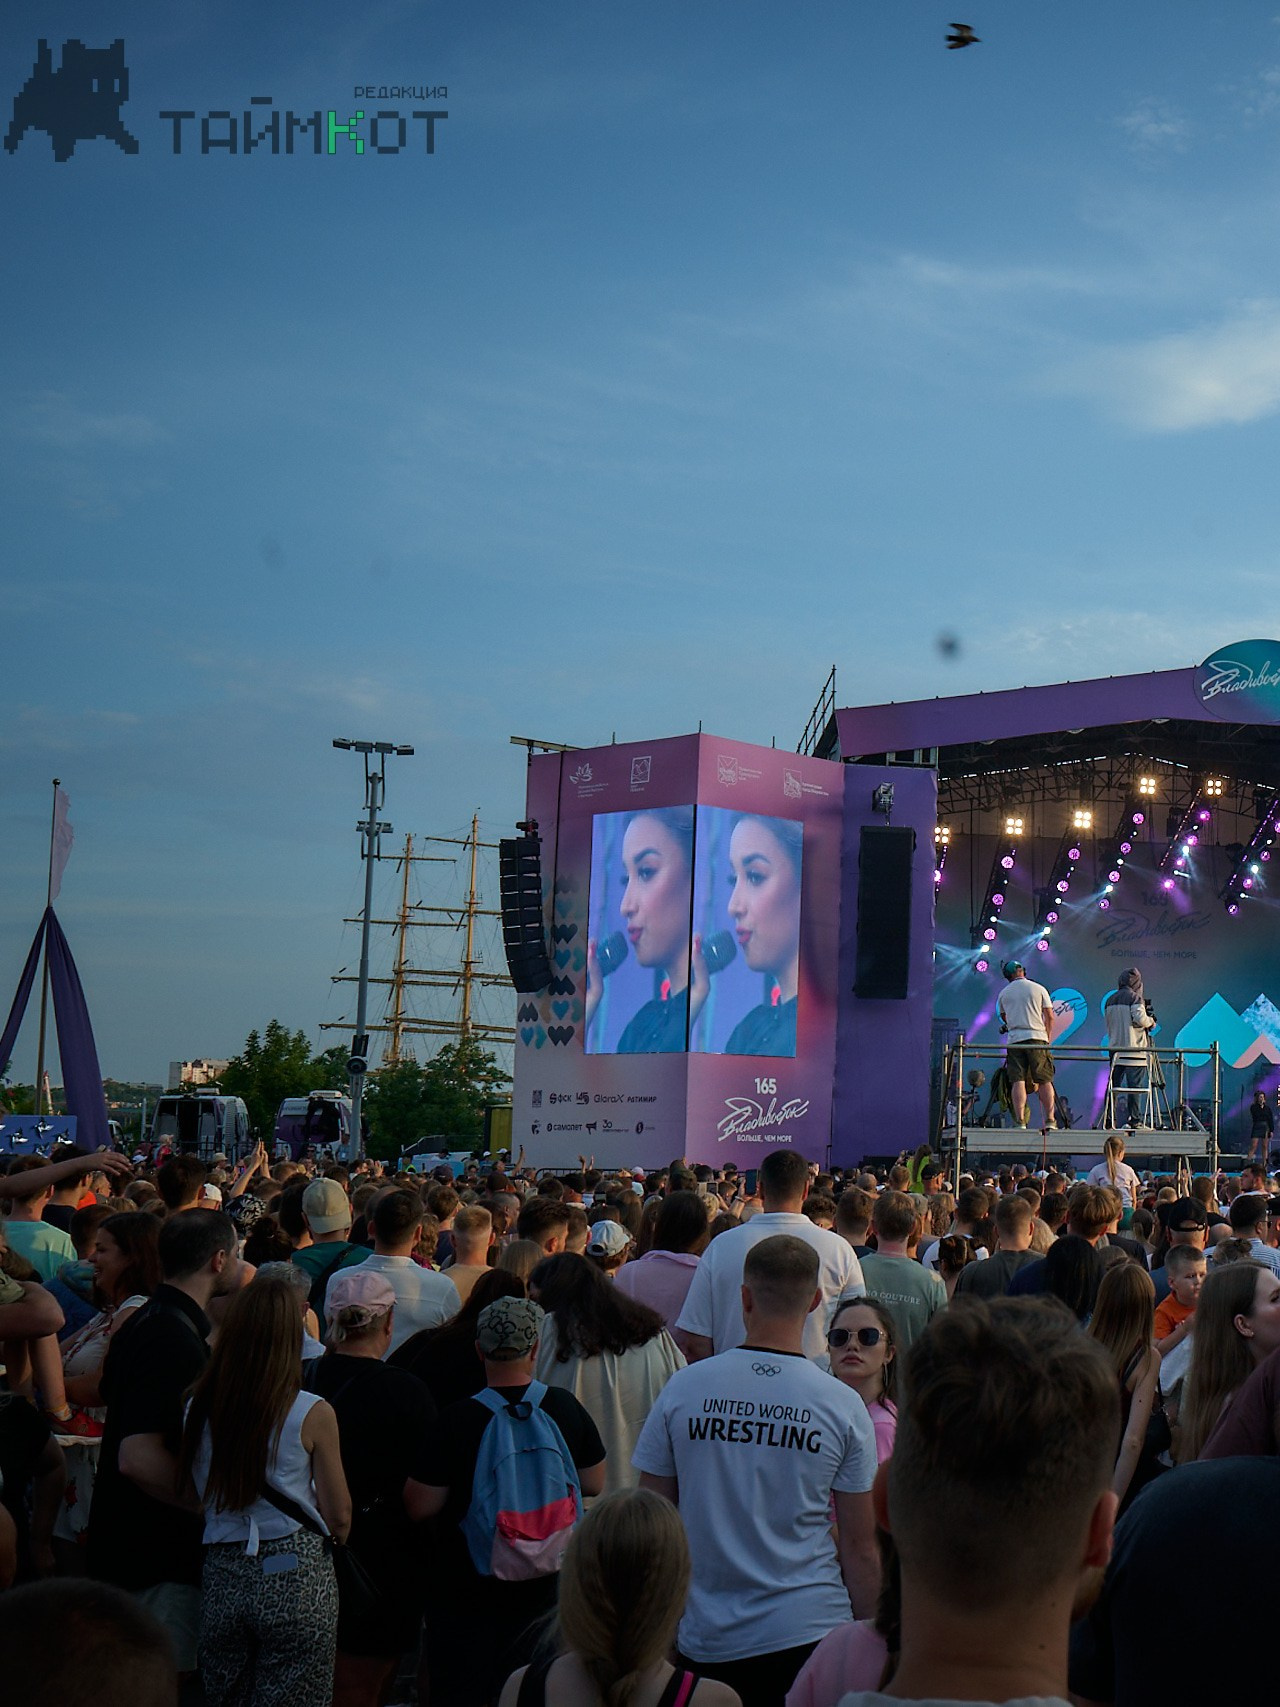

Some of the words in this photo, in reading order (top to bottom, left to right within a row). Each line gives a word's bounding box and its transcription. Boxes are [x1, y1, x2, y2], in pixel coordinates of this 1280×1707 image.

[1096, 908, 1212, 949] Владивосток
[1153, 950, 1171, 959] ЧЕМ
[1174, 951, 1198, 960] МОРЕ
[754, 1077, 778, 1095] 165
[717, 1096, 810, 1142] Владивосток
[736, 1134, 764, 1143] БОЛЬШЕ,
[764, 1134, 777, 1142] ЧЕМ
[777, 1135, 793, 1143] МОРЕ
[879, 1292, 921, 1305] COUTURE
[703, 1399, 755, 1416] UNITED
[759, 1404, 811, 1424] WORLD
[688, 1417, 822, 1454] WRESTLING
